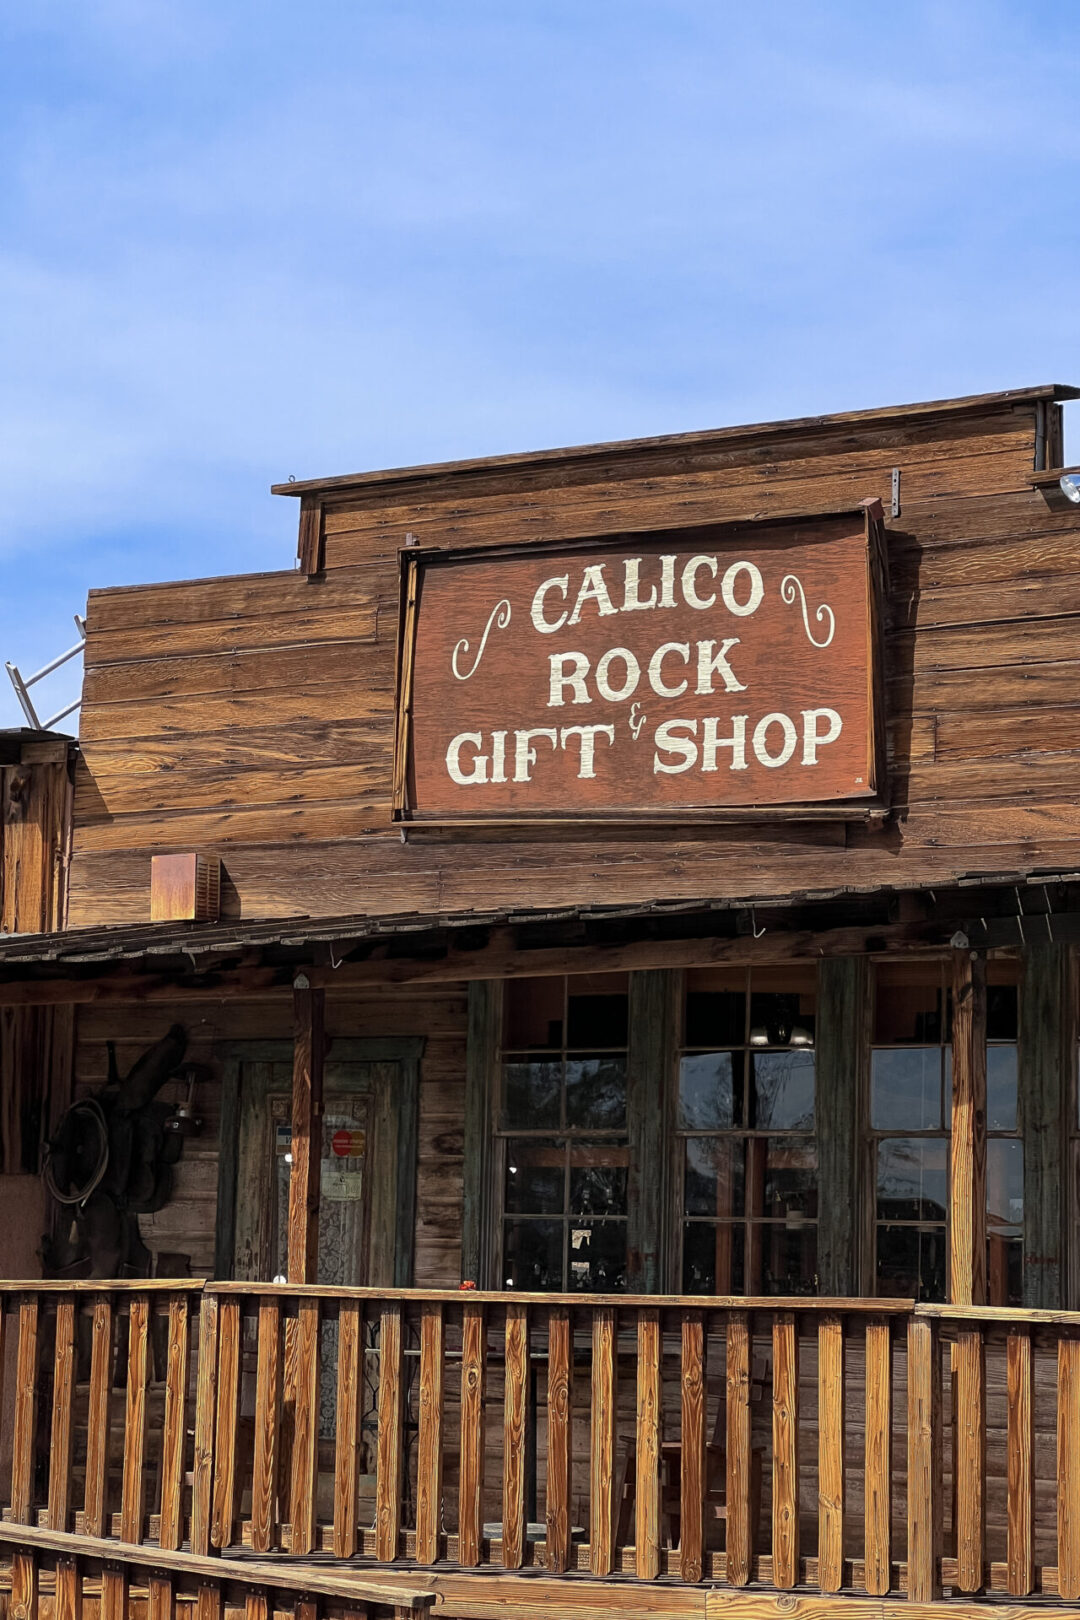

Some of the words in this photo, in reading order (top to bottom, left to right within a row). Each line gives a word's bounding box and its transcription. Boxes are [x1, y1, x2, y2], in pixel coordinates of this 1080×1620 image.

[530, 555, 765, 634] CALICO
[547, 637, 748, 707] ROCK
[445, 724, 615, 785] GIFT
[653, 707, 844, 775] SHOP
[628, 702, 647, 740] &
